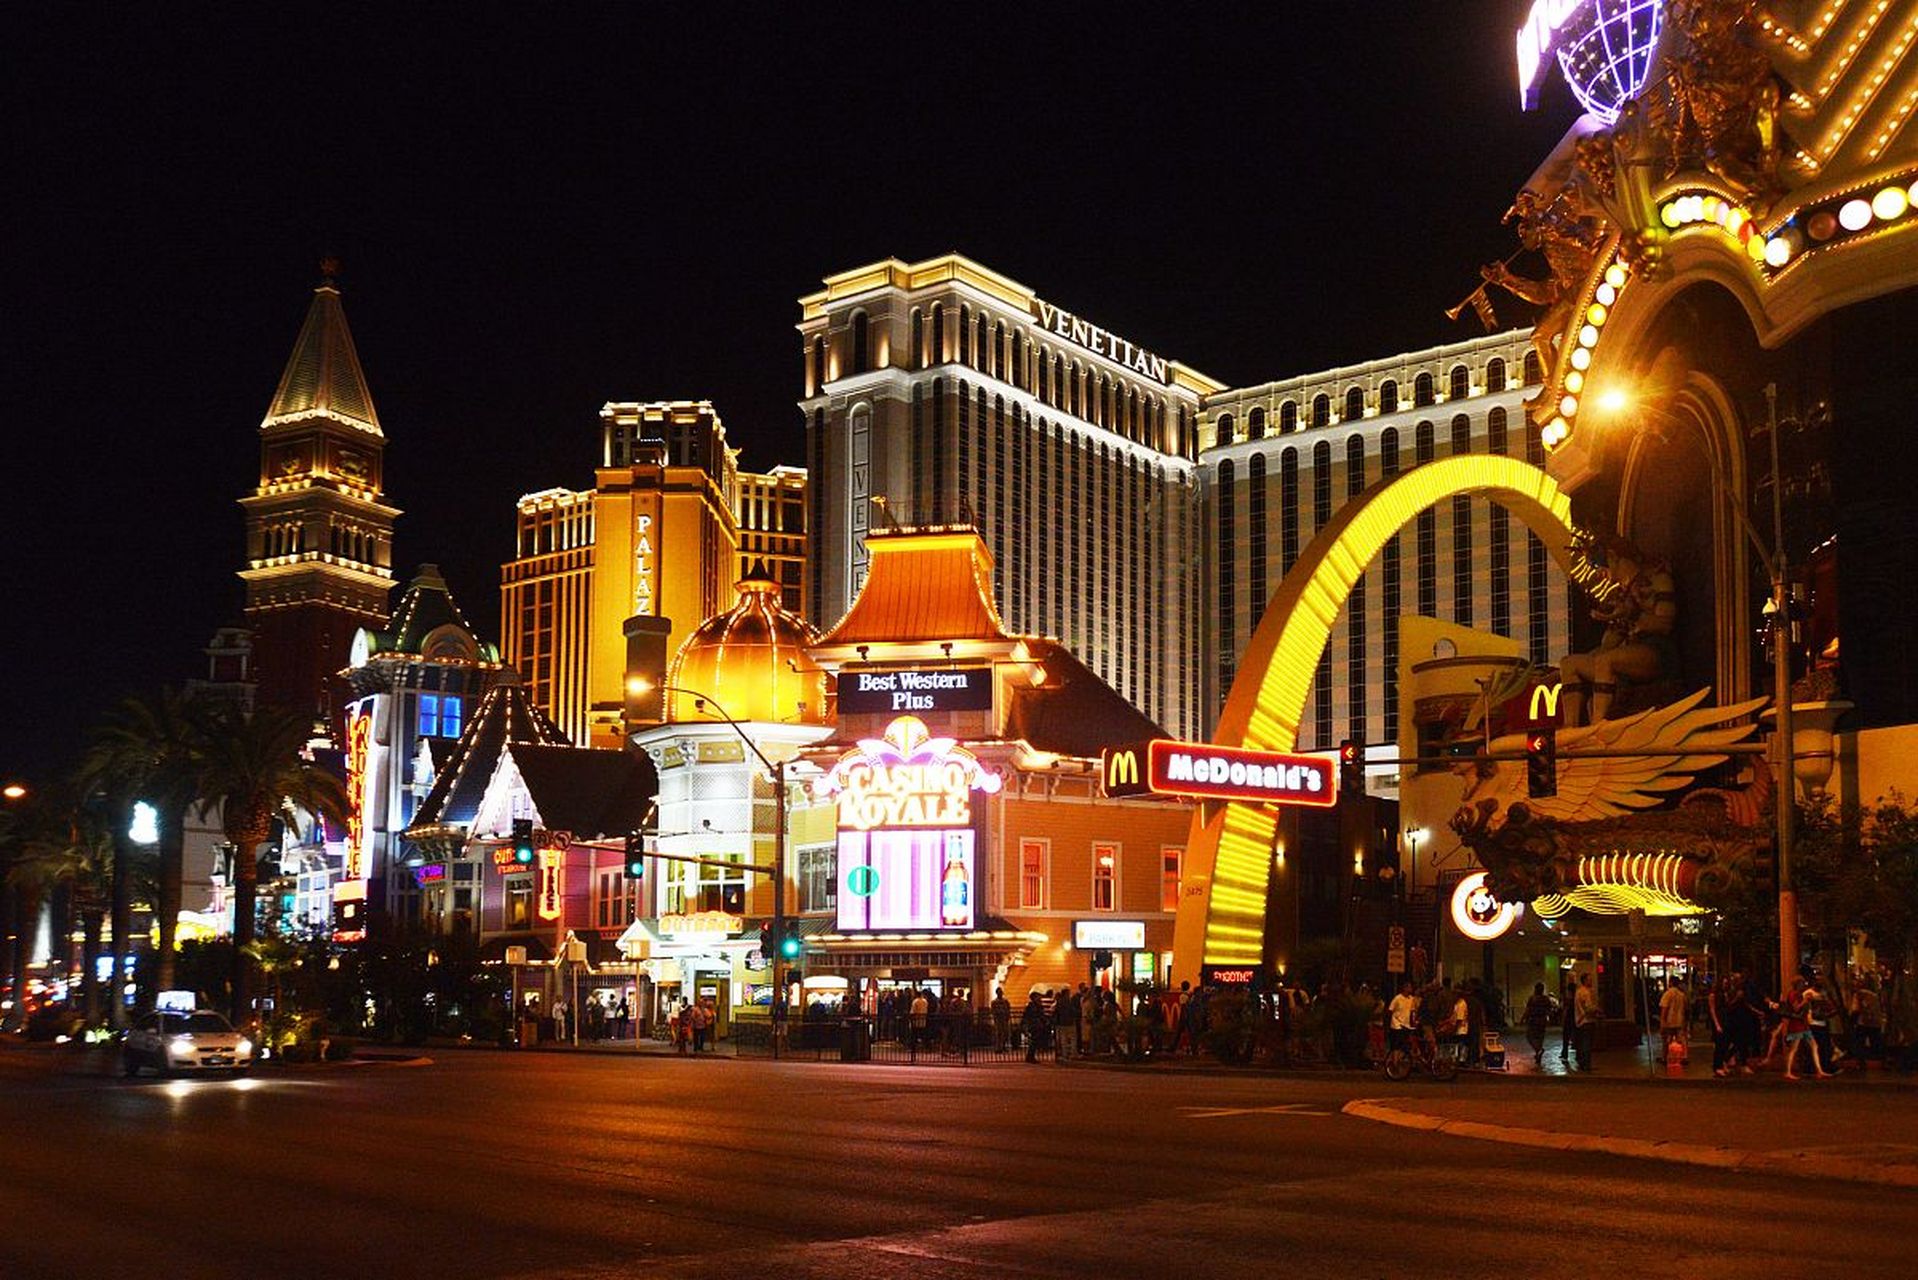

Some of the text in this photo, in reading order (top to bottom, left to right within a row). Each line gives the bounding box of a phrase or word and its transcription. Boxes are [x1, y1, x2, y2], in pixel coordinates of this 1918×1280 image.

[1037, 298, 1167, 384] VENETIAN
[859, 671, 968, 691] Best Western
[892, 691, 934, 710] Plus
[849, 764, 966, 794] CASINO
[1167, 753, 1322, 792] McDonald's
[836, 791, 970, 829] ROYALE
